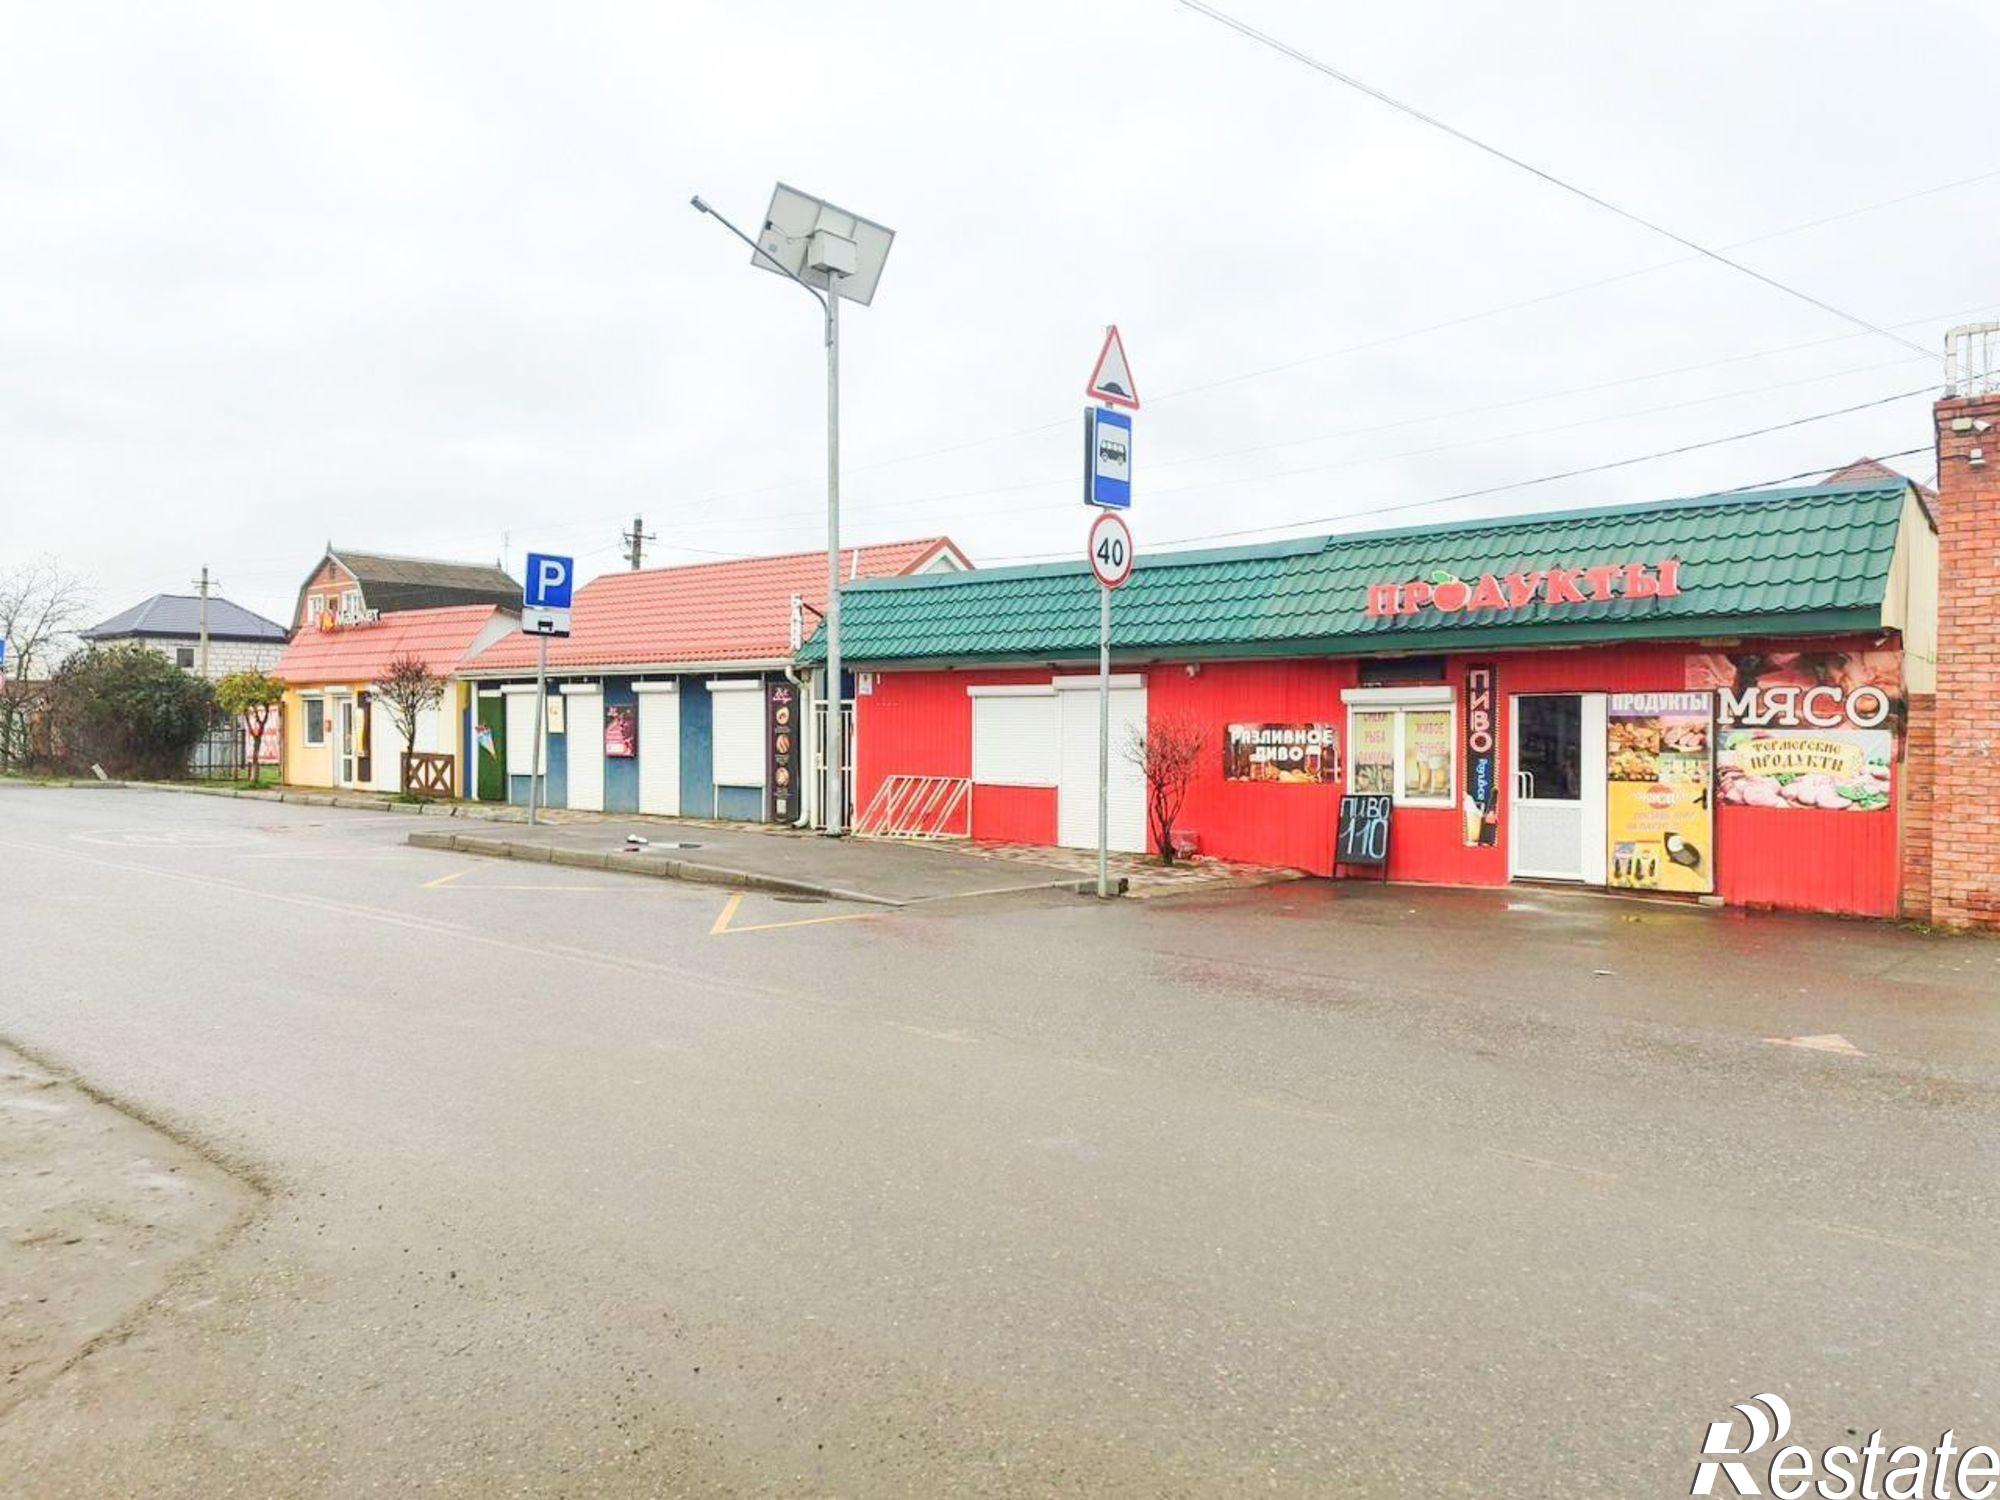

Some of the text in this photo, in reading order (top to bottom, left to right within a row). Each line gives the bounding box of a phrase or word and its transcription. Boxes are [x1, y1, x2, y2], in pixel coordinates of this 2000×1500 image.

[1096, 537, 1124, 567] 40
[537, 559, 566, 601] P
[1367, 560, 1680, 617] ПРОДУКТЫ
[1469, 669, 1493, 753] ПИВО
[1611, 692, 1708, 713] ПРОДУКТЫ
[1716, 685, 1890, 728] МЯСО
[1227, 723, 1333, 745] РАЗЛИВНОЕ
[1339, 796, 1390, 820] ПИВО
[1339, 817, 1389, 860] 110
